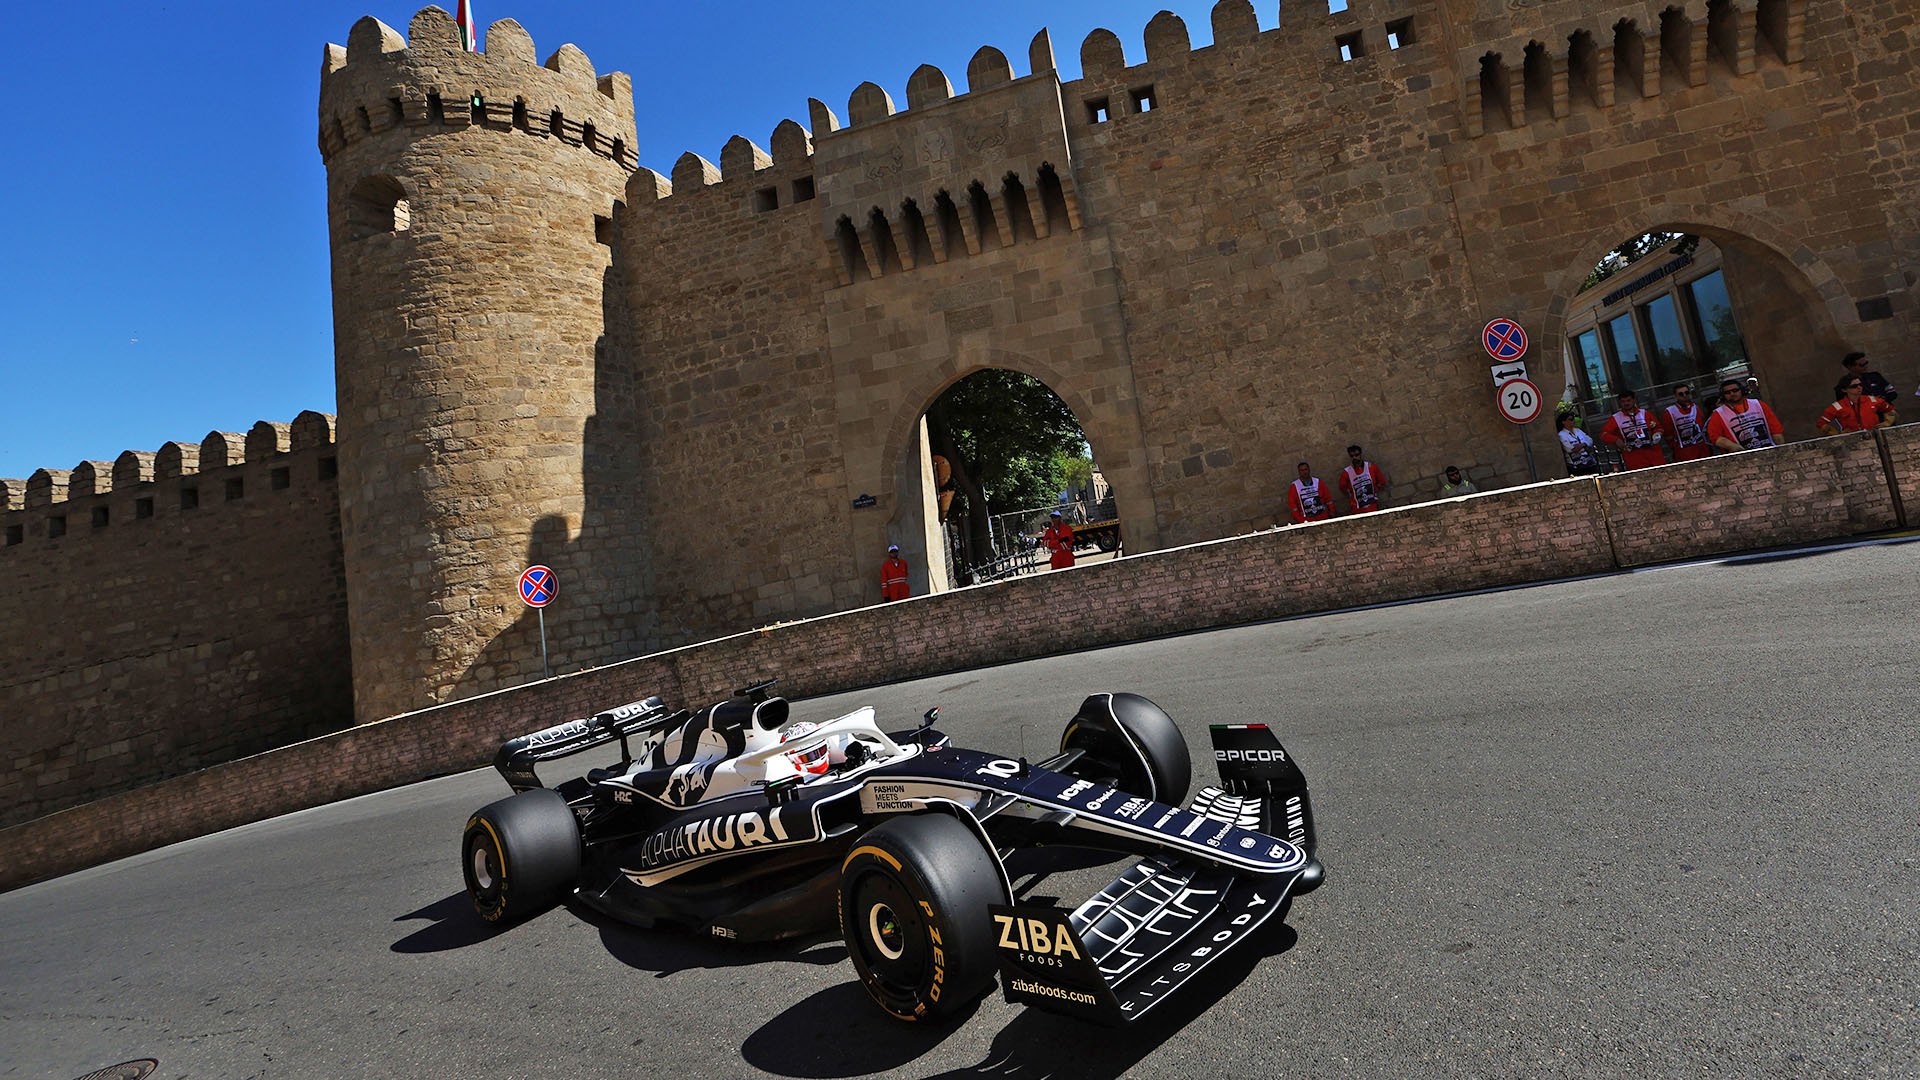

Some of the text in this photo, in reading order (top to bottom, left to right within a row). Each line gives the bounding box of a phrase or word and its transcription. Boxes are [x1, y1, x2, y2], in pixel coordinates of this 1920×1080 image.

[1508, 391, 1532, 410] 20
[977, 759, 1020, 779] 10
[874, 785, 905, 793] FASHION
[875, 793, 899, 801] MEETS
[876, 801, 913, 809] FUNCTION
[1114, 797, 1146, 818] ZIBA
[993, 914, 1081, 961] ZIBA
[919, 900, 945, 1003] P ZERO
[1019, 953, 1063, 968] FOODS
[1011, 979, 1096, 1006] zibafoods.com
